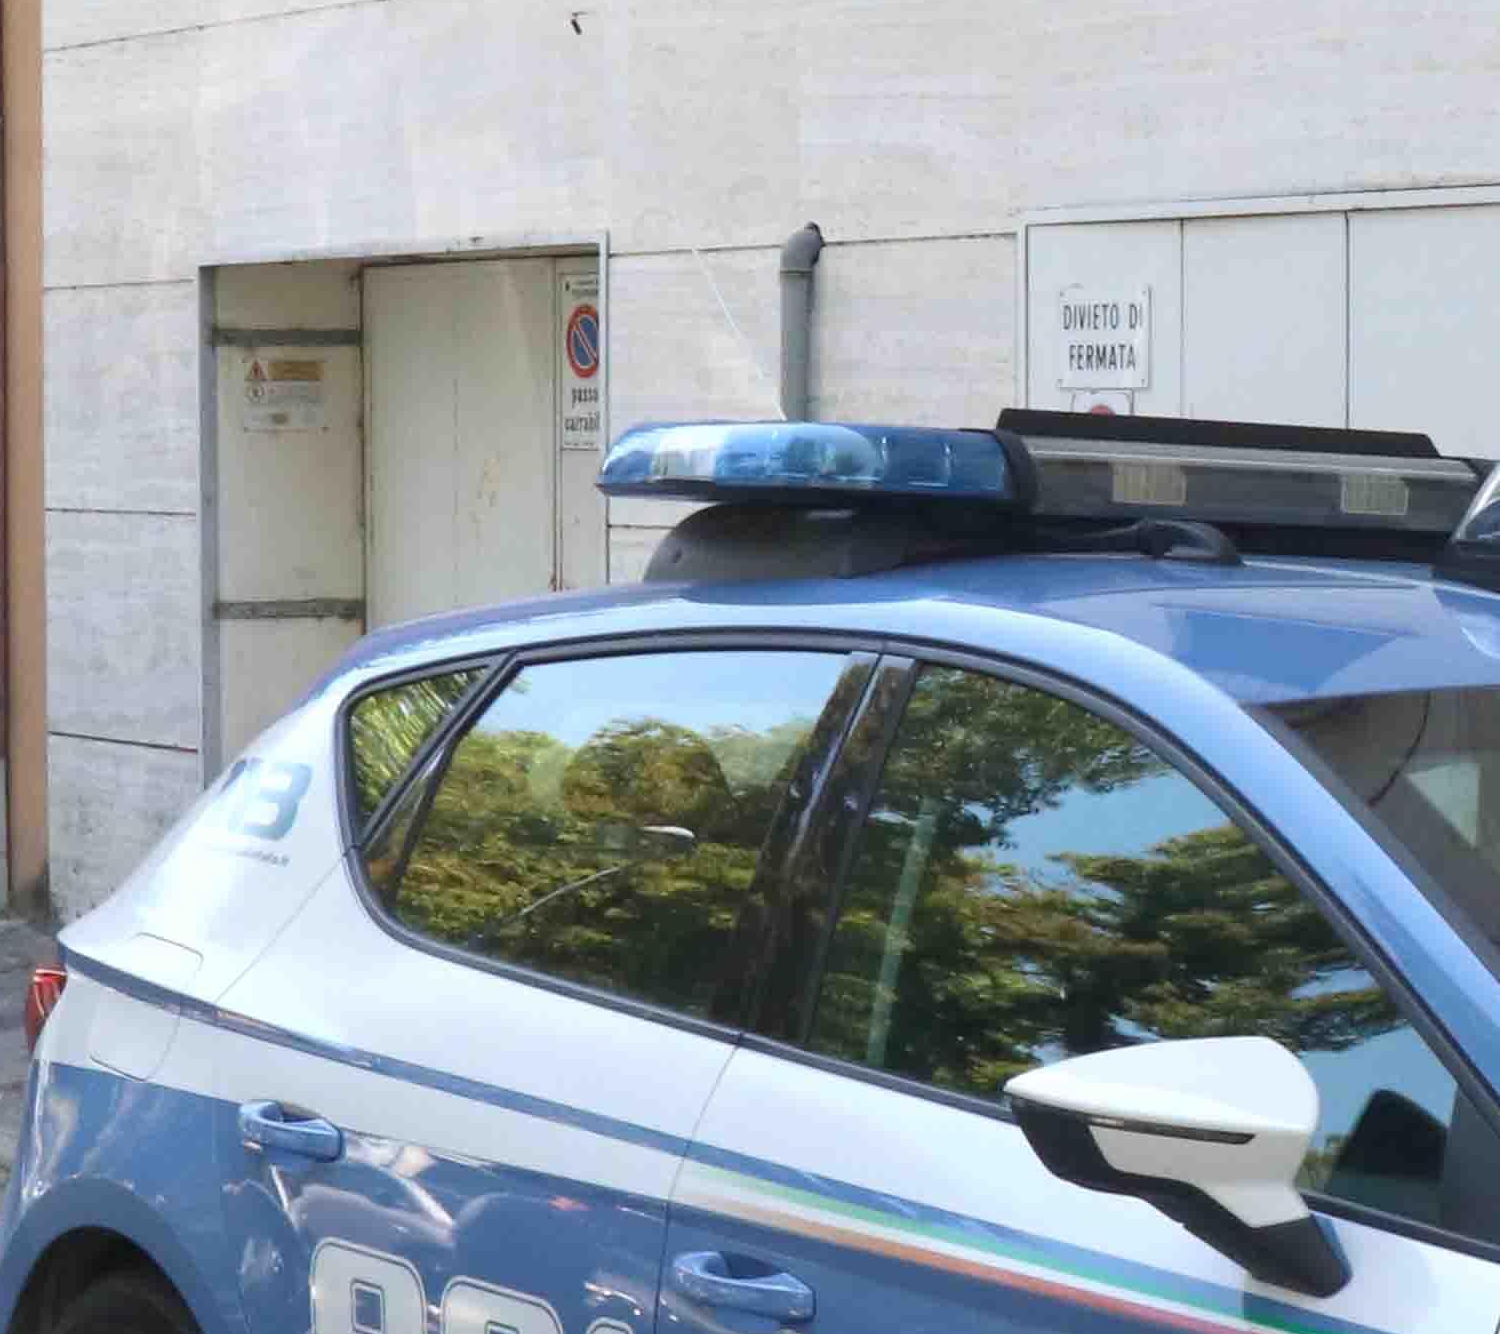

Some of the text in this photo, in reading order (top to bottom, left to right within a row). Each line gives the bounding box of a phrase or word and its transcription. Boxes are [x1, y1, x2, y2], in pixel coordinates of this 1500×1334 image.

[1062, 303, 1143, 330] DIVIETO DI
[1068, 344, 1136, 372] FERMATA
